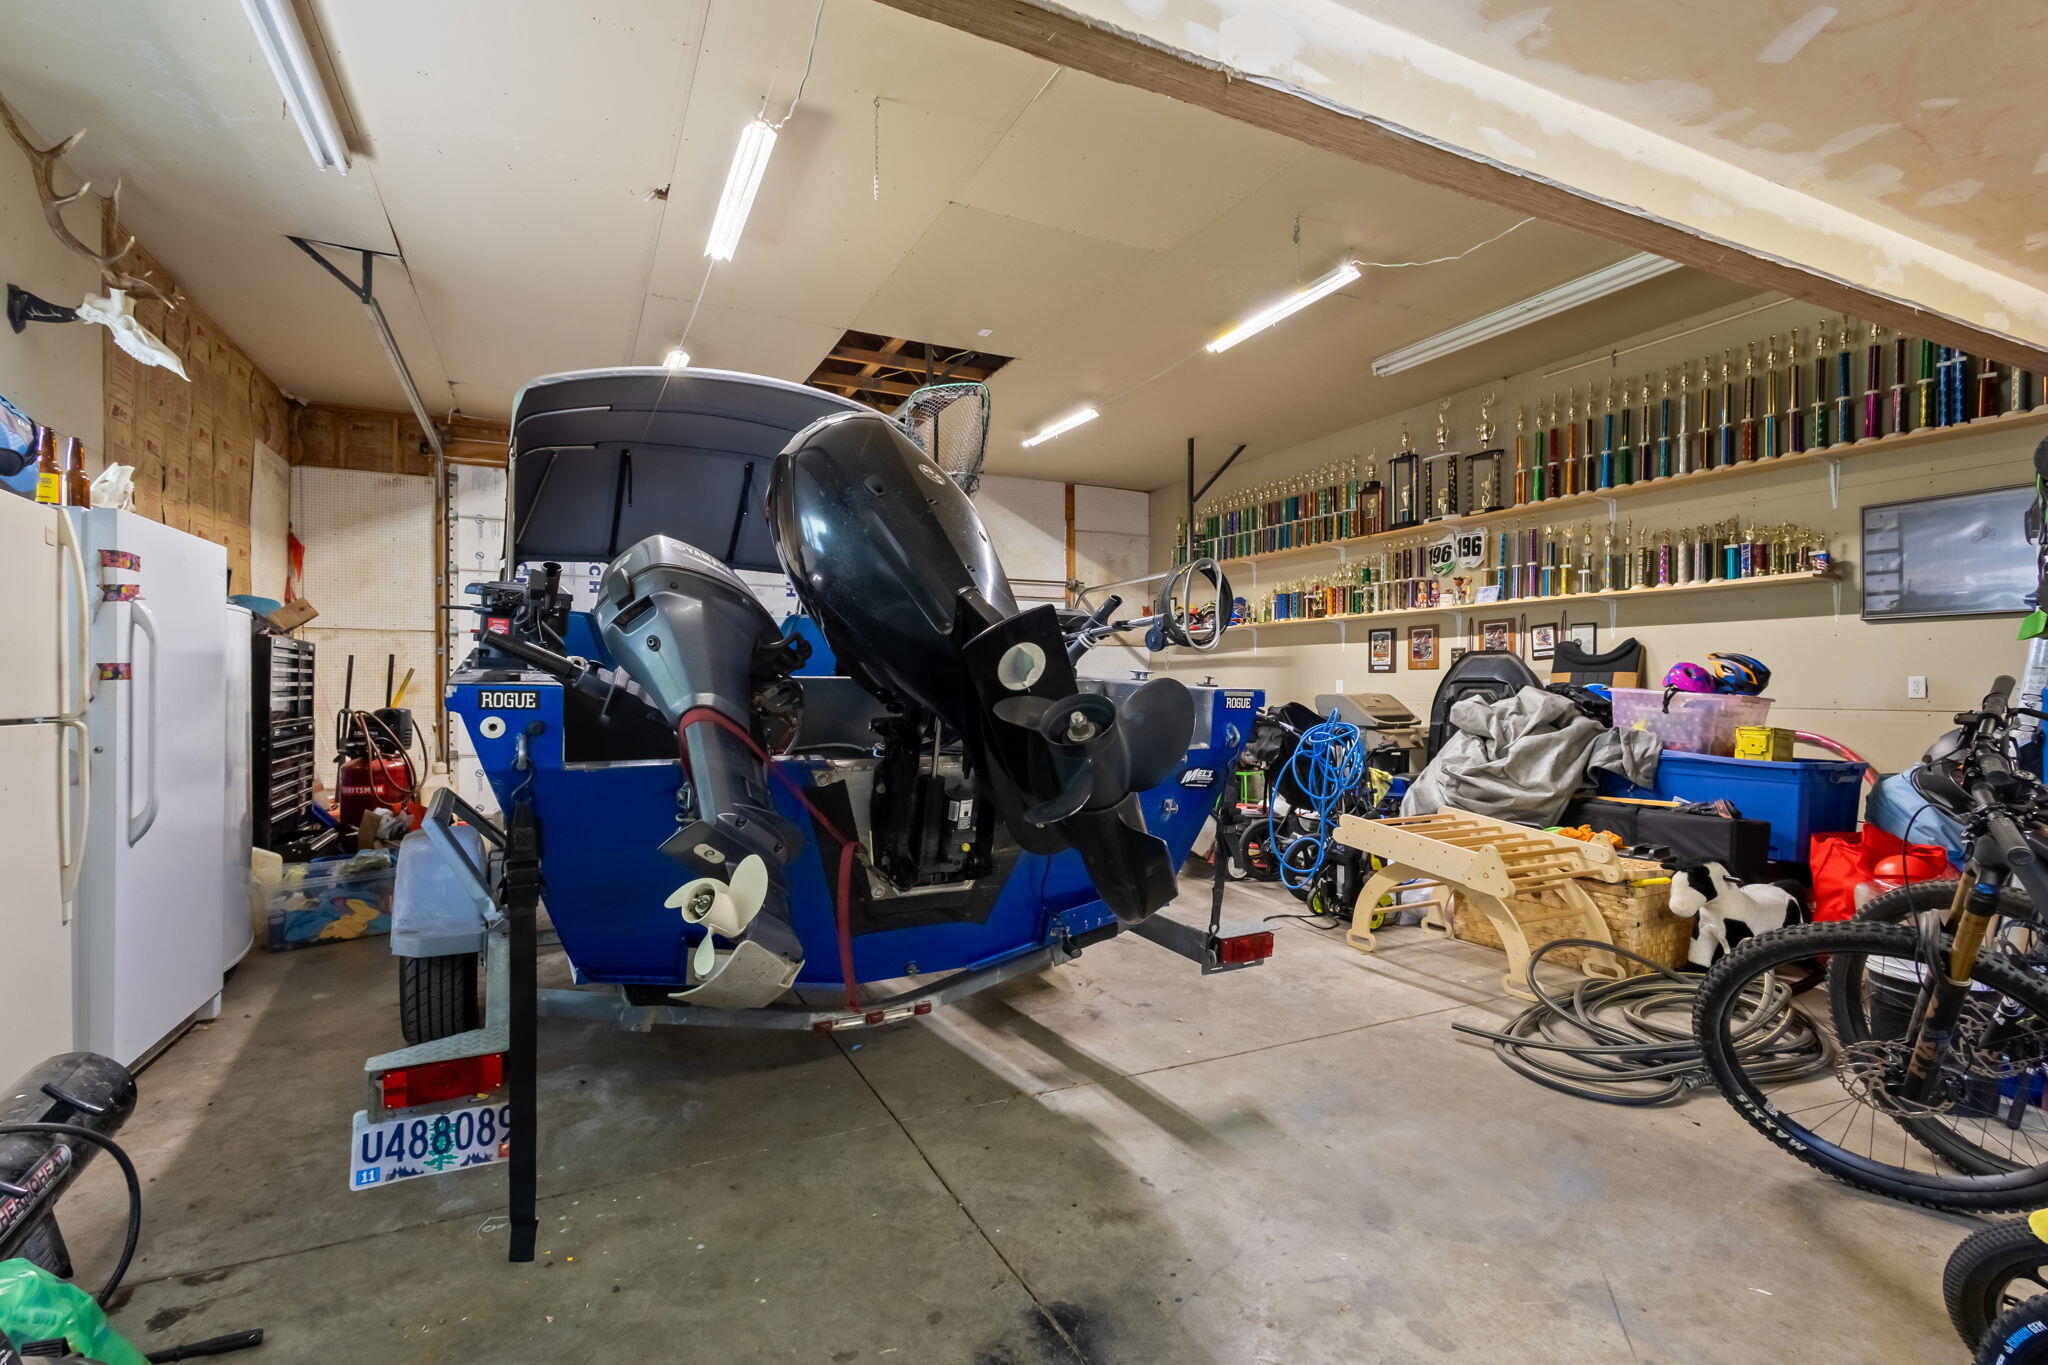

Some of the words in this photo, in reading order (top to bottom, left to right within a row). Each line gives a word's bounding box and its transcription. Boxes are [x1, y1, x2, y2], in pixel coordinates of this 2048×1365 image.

[1429, 545, 1452, 565] 196
[1457, 536, 1482, 557] 196
[481, 691, 536, 708] ROGUE
[1226, 697, 1251, 708] ROGUE
[1736, 1094, 1807, 1151] MAXXIS
[361, 1170, 376, 1184] 11
